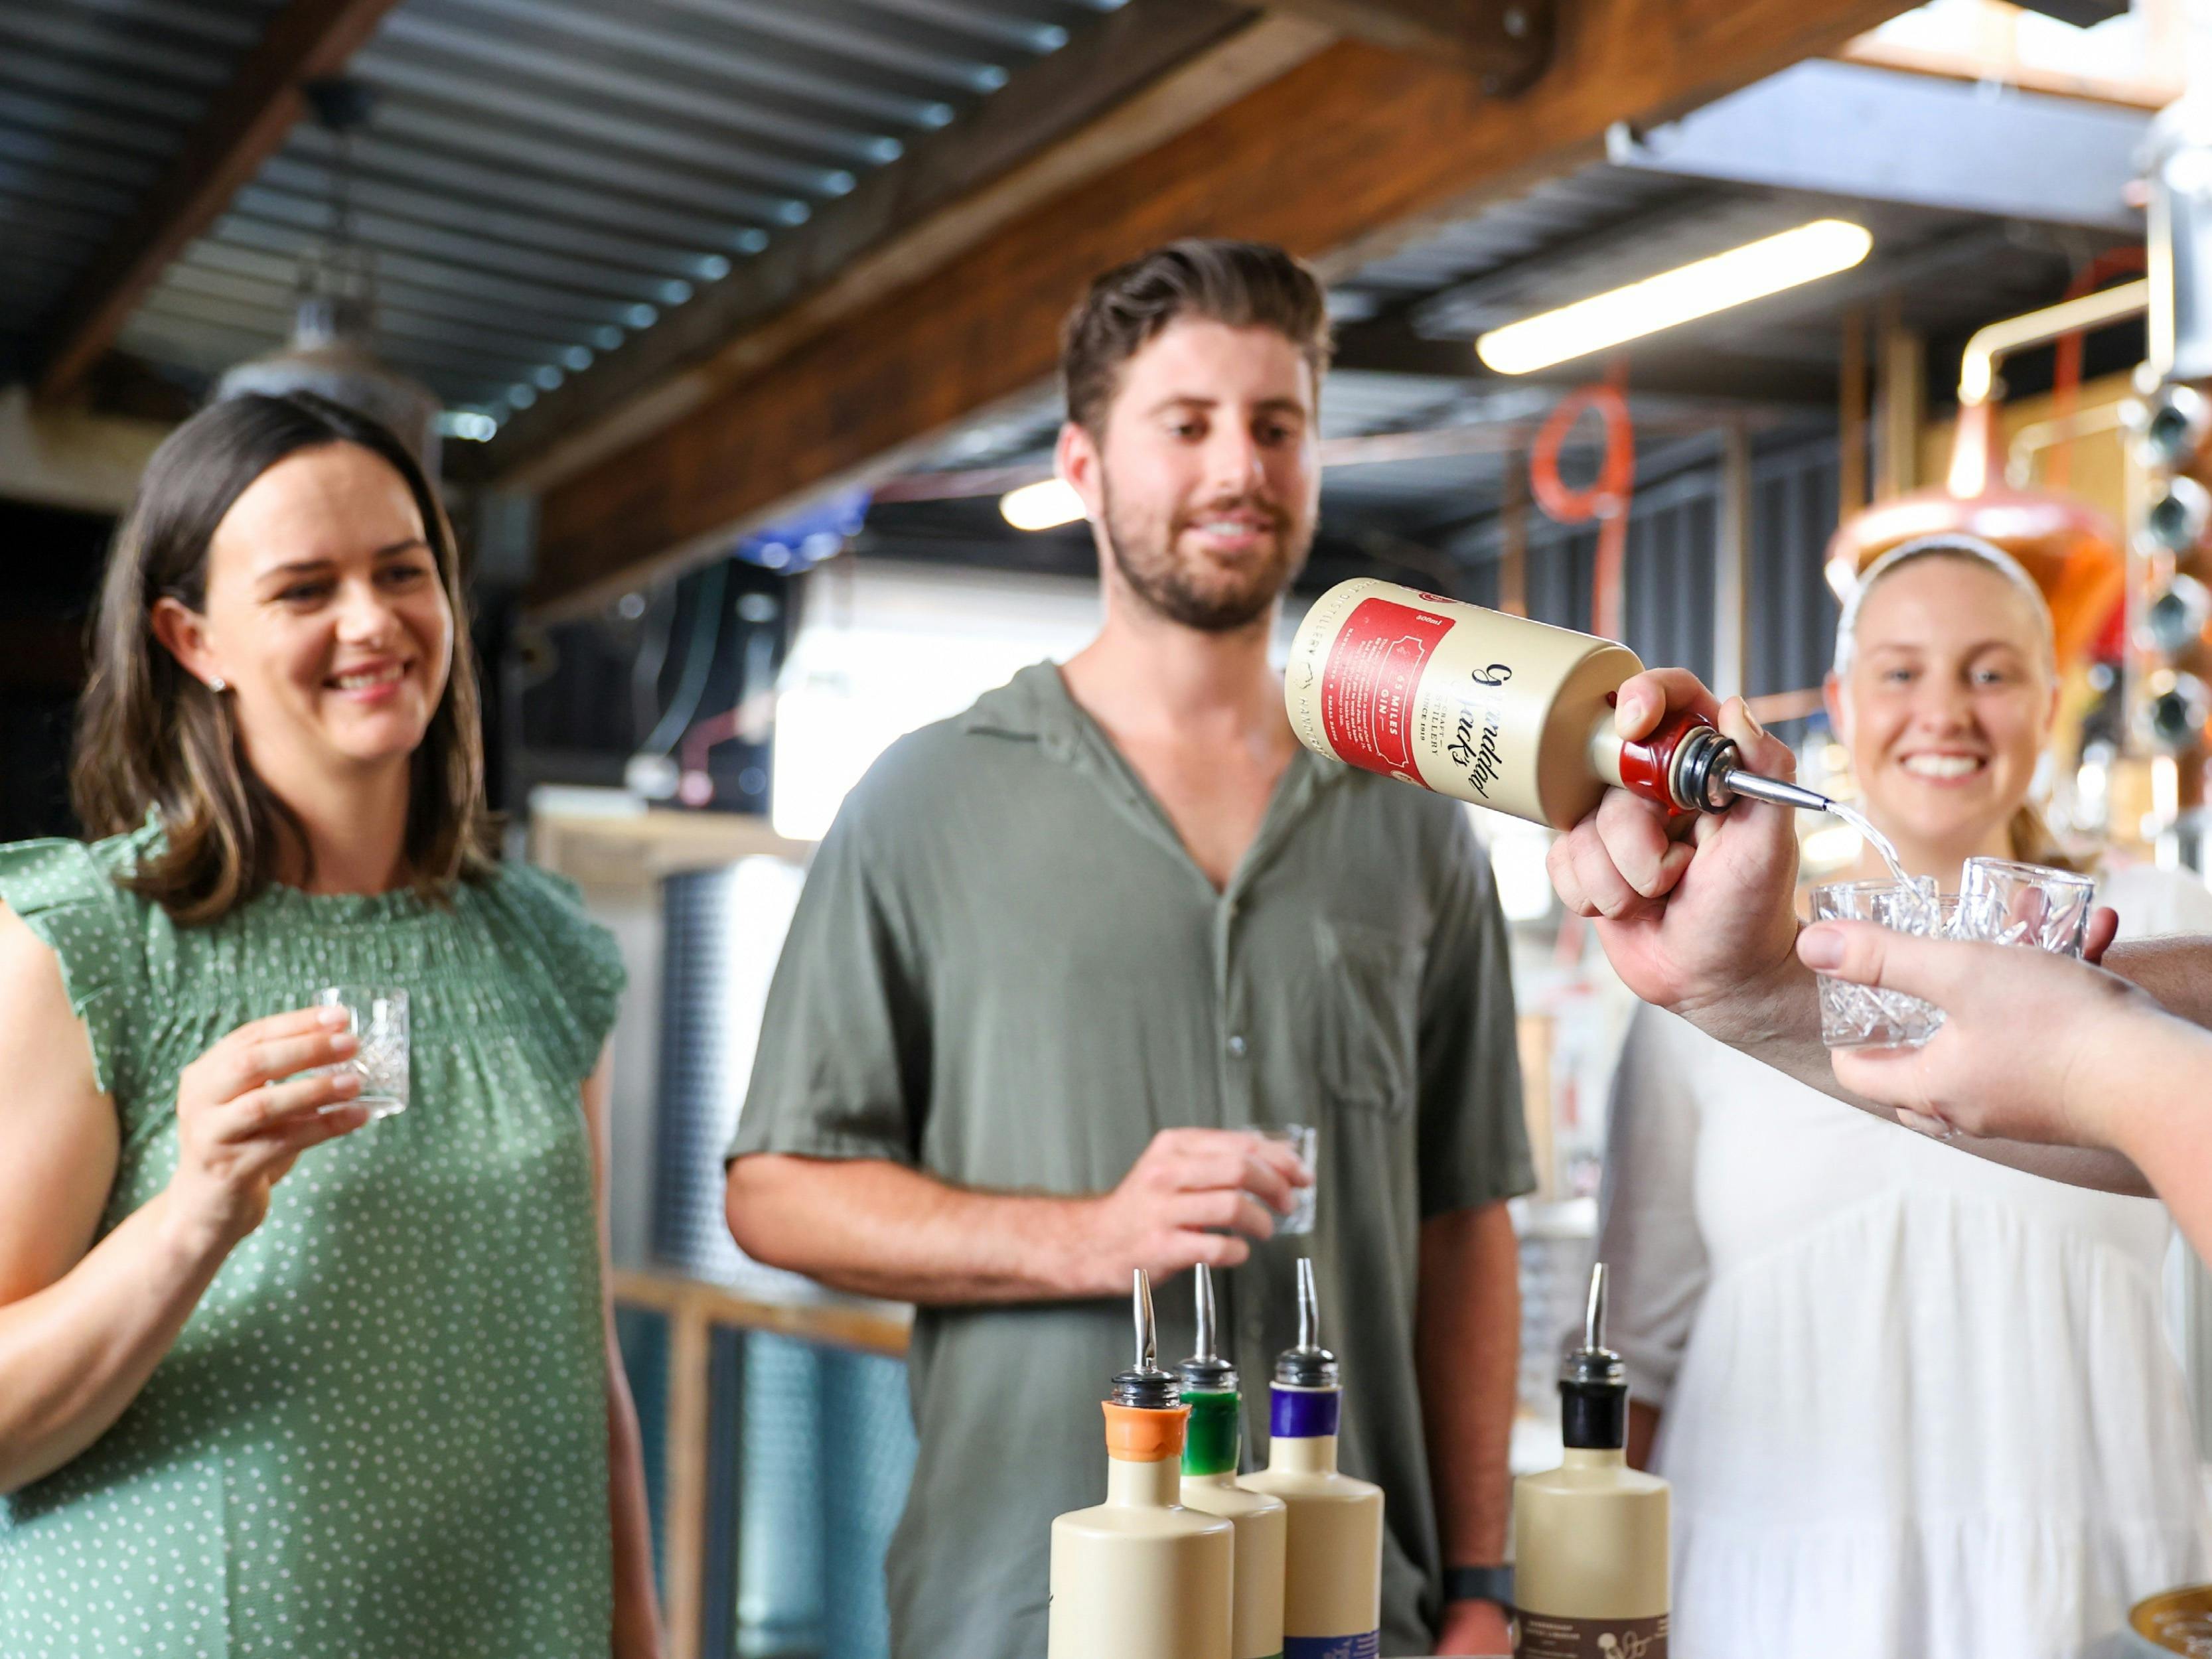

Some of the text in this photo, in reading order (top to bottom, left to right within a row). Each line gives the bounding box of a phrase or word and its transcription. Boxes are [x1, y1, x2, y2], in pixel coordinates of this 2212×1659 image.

[1378, 689, 1390, 715] GIN
[1389, 674, 1405, 735] 65 MILES
[1421, 691, 1431, 720] SINCE
[1329, 721, 1338, 741] BATCH
[1430, 689, 1441, 757] STILLERY
[1439, 705, 1447, 737] CRAFT
[1468, 664, 1512, 799] Ganddad
